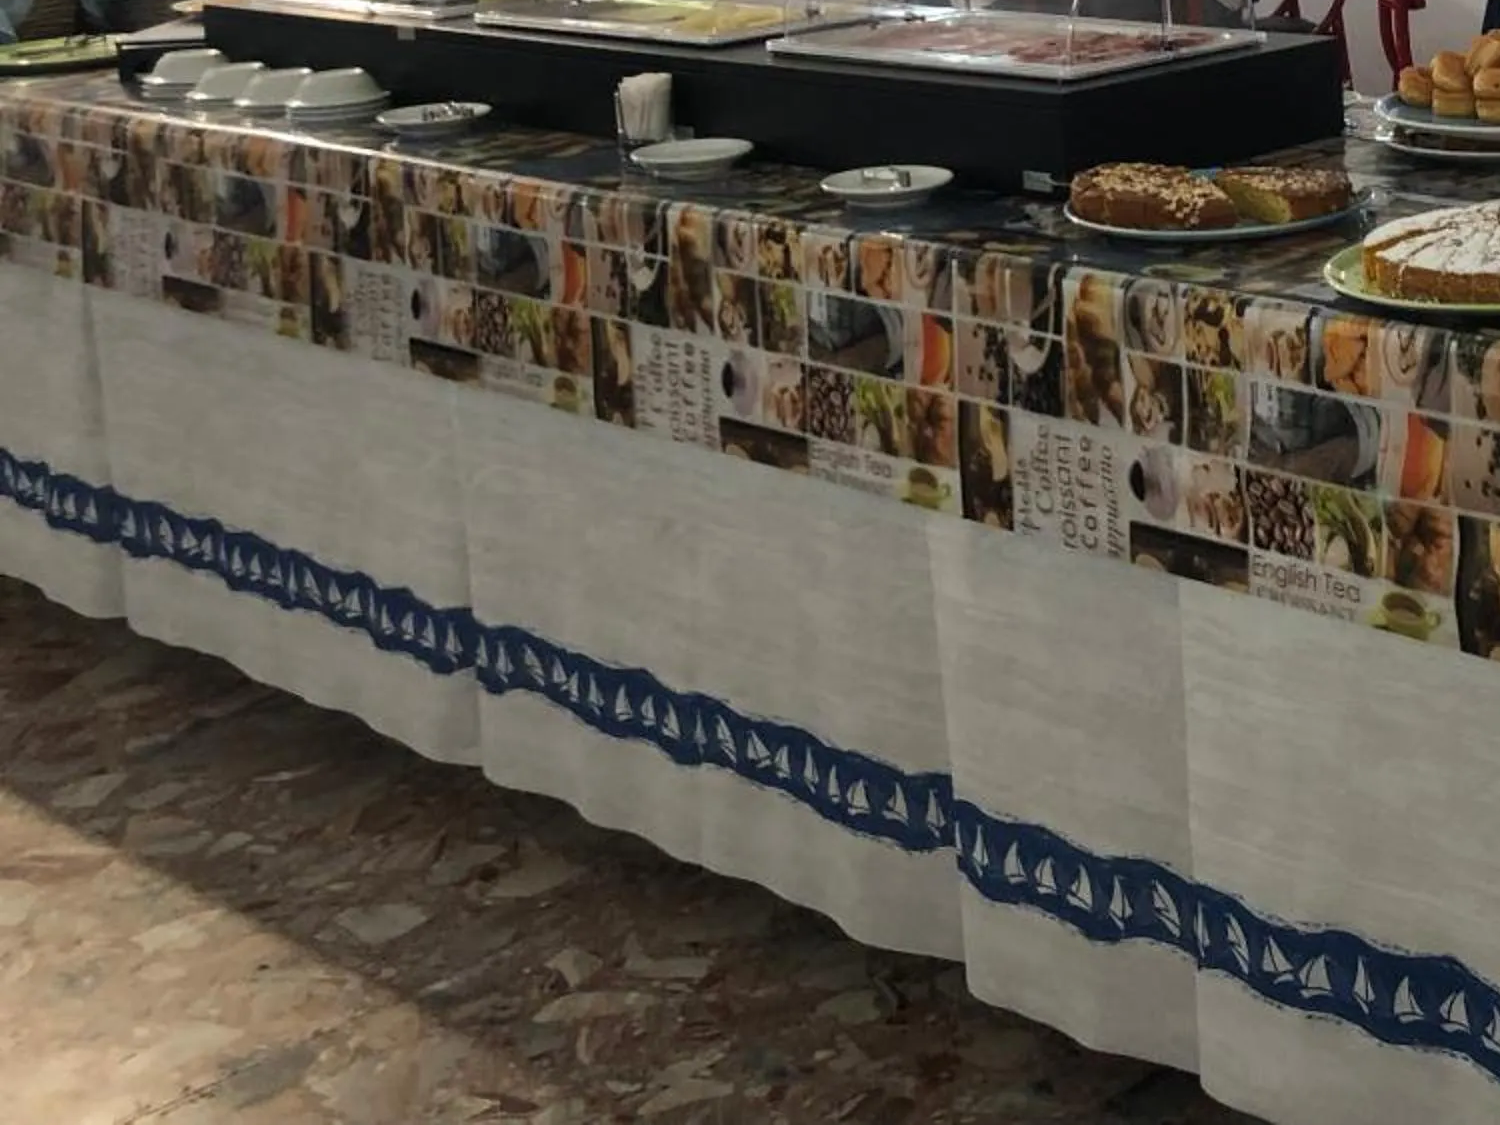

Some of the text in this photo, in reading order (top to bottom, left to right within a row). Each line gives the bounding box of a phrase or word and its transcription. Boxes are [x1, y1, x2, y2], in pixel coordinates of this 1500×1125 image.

[1030, 424, 1053, 515] Coffee
[1075, 434, 1098, 551] Coffee
[1323, 572, 1361, 603] Tea
